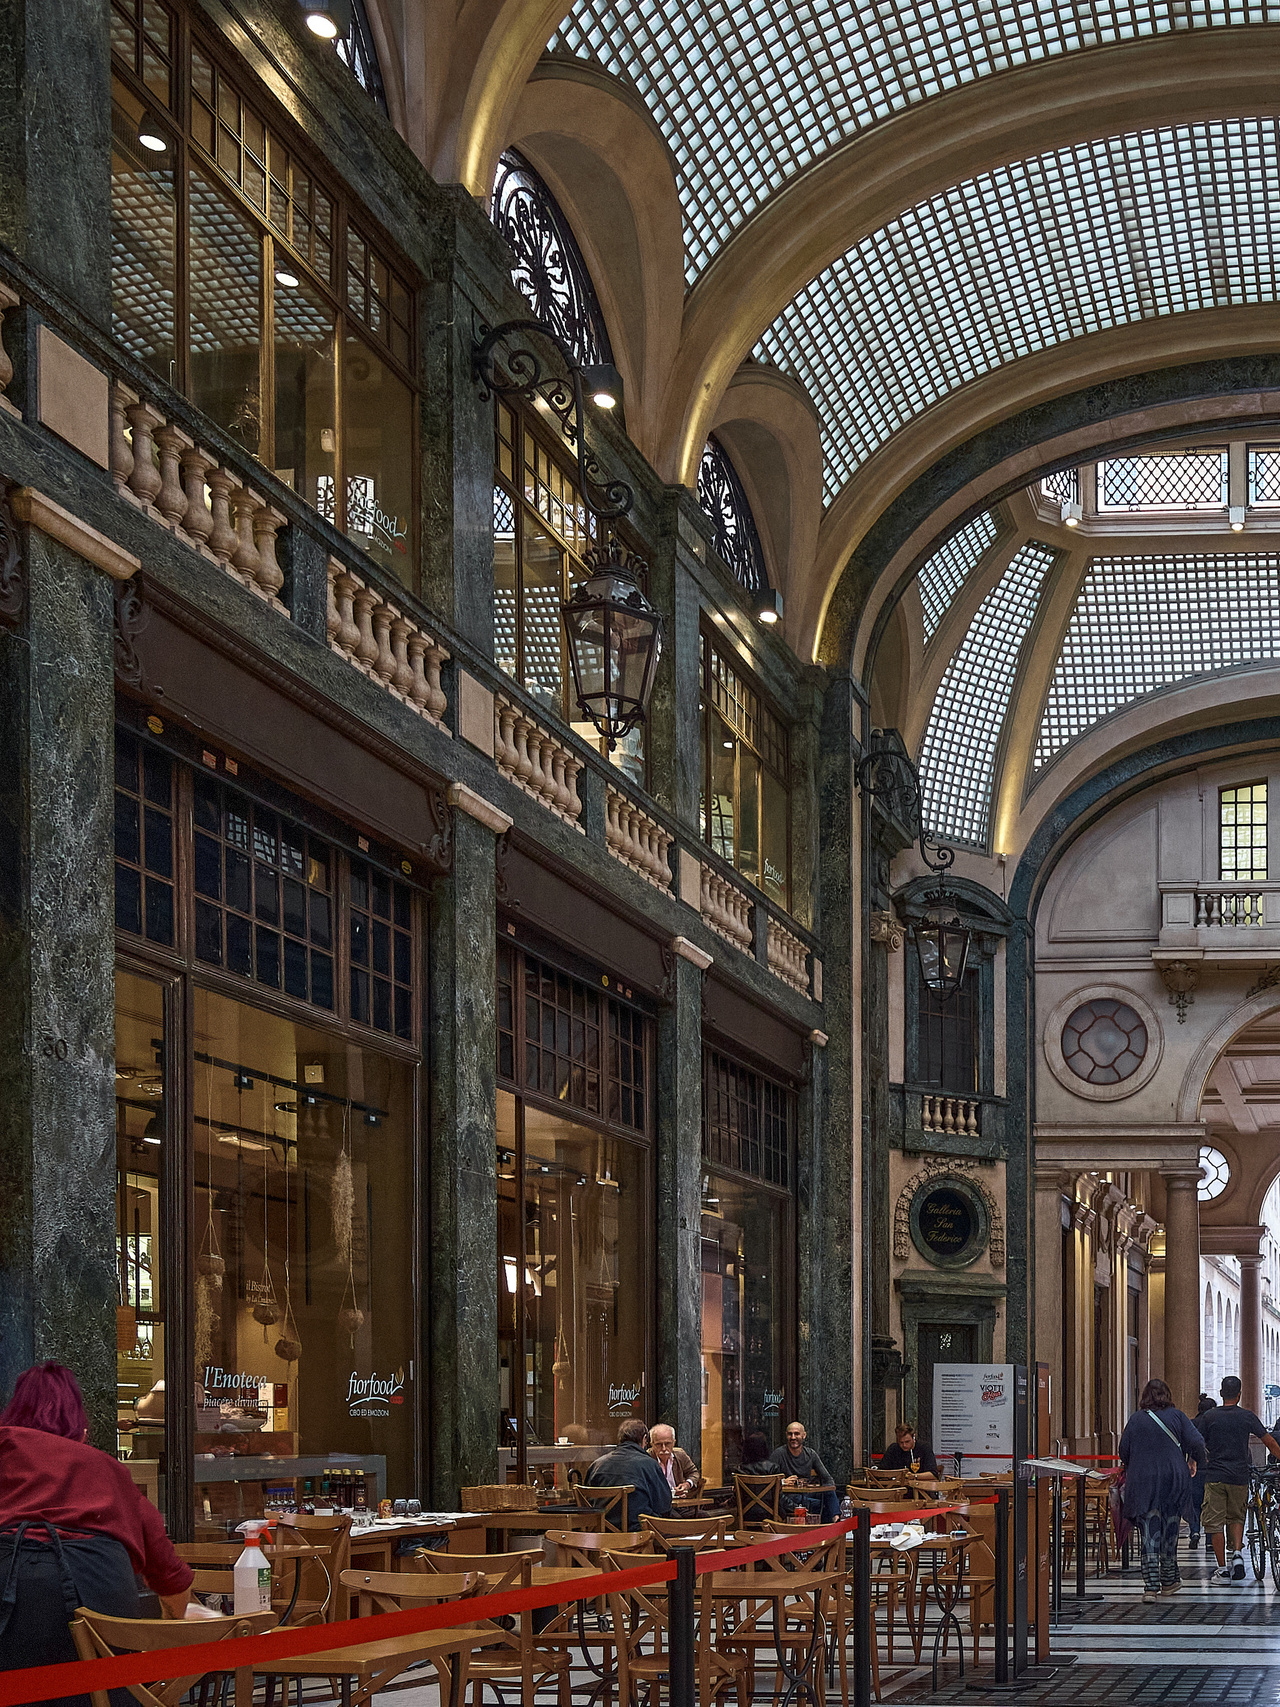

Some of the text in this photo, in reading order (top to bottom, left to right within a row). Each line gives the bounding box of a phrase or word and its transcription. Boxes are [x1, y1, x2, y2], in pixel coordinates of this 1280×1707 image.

[926, 1202, 962, 1216] Galleria
[933, 1216, 954, 1229] San
[926, 1230, 963, 1243] Federico
[204, 1366, 267, 1389] l'Enoteca
[346, 1371, 400, 1401] fiorfood
